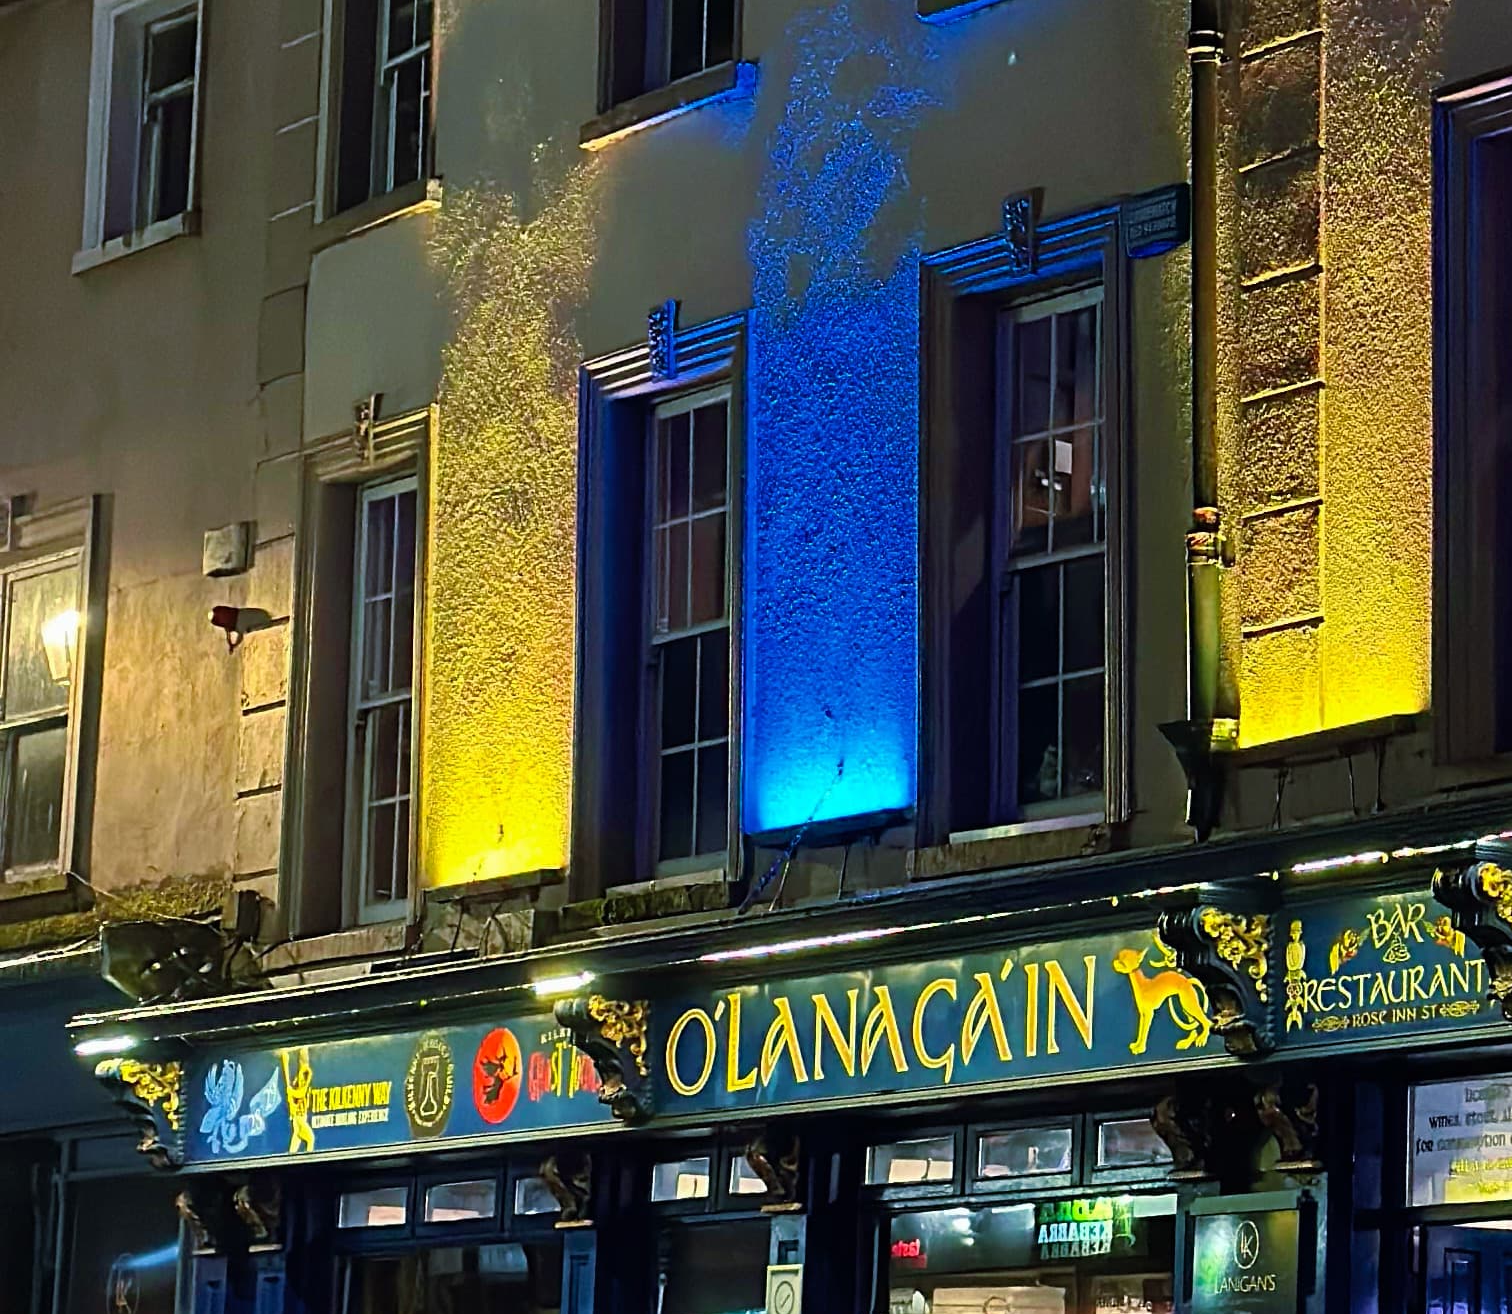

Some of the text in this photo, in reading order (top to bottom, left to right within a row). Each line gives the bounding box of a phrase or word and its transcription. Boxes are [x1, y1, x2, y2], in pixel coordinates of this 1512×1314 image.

[1367, 902, 1426, 949] BAR
[1303, 958, 1486, 1013] RESTAURANT
[1392, 1007, 1417, 1024] INN
[310, 1088, 329, 1114] THE
[372, 1081, 392, 1105] WAY
